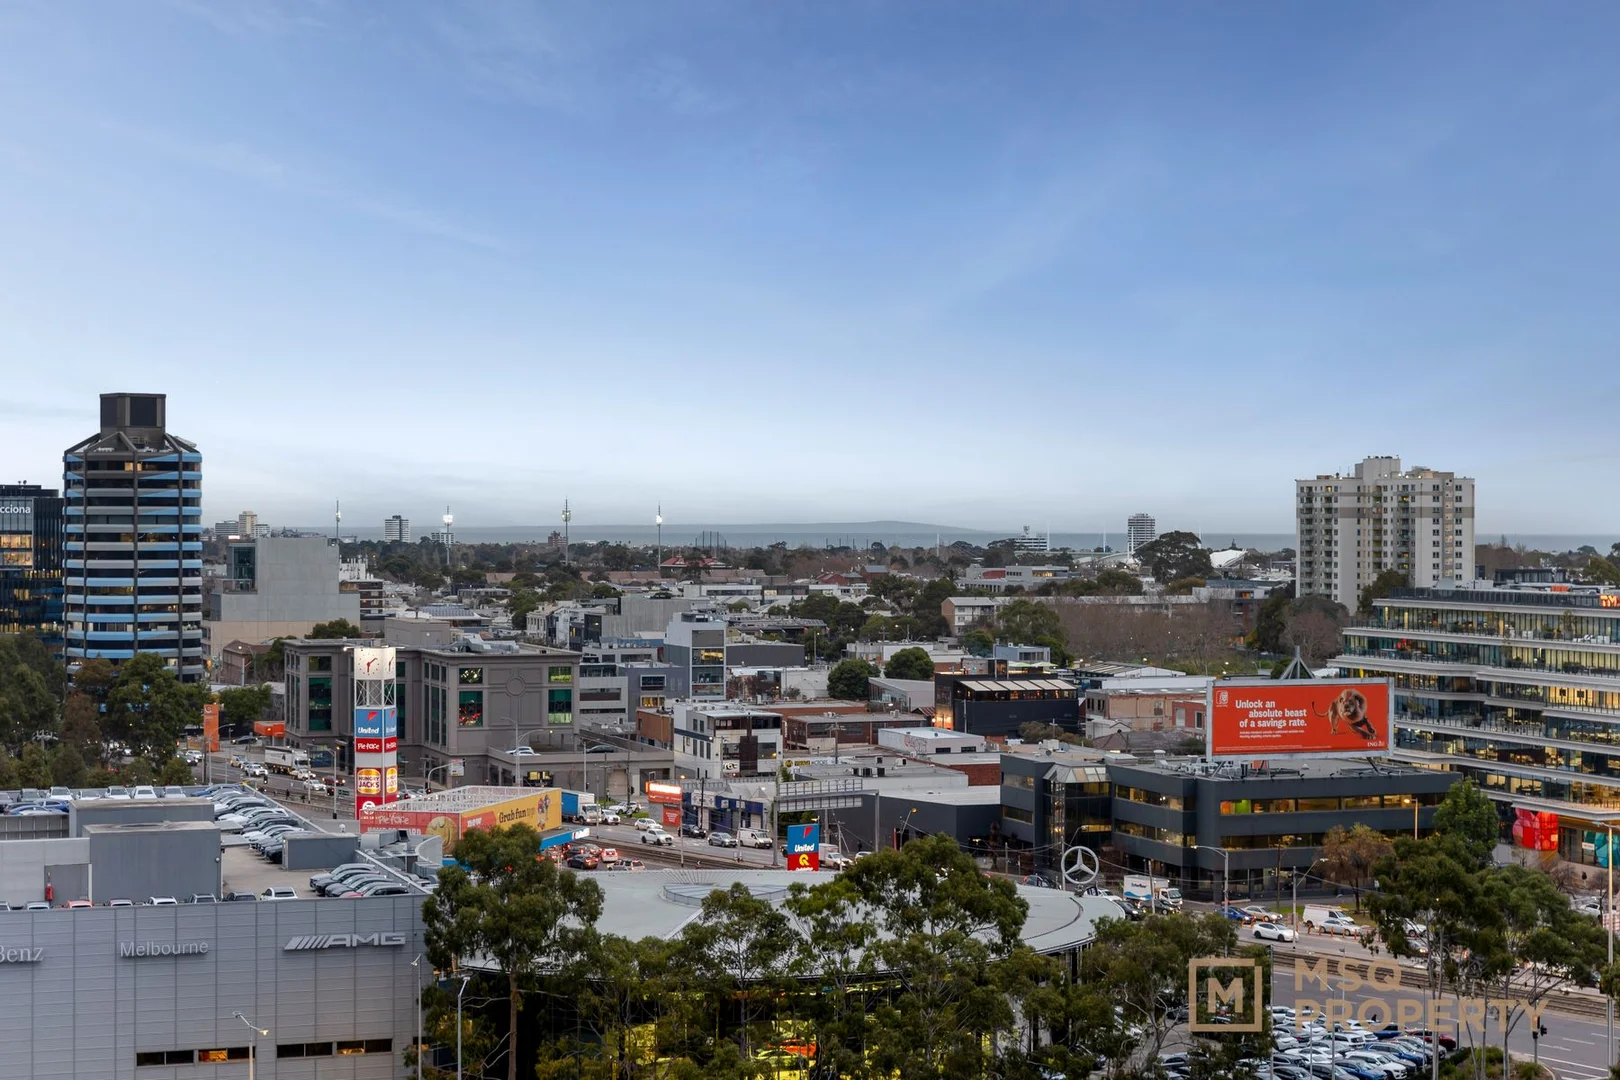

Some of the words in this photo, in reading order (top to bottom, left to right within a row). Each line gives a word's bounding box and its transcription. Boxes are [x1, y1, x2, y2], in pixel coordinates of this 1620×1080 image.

[1235, 699, 1263, 709] Unlock
[1265, 700, 1276, 709] an
[1248, 709, 1283, 718] absolute
[1284, 708, 1307, 717] beast
[1239, 719, 1248, 728] of
[1250, 720, 1256, 728] a
[1257, 718, 1287, 729] savings
[1288, 719, 1307, 727] rate.
[357, 726, 380, 734] United
[498, 809, 515, 823] Grab
[515, 808, 527, 819] fun
[794, 843, 815, 852] United
[120, 941, 209, 957] Melbourne
